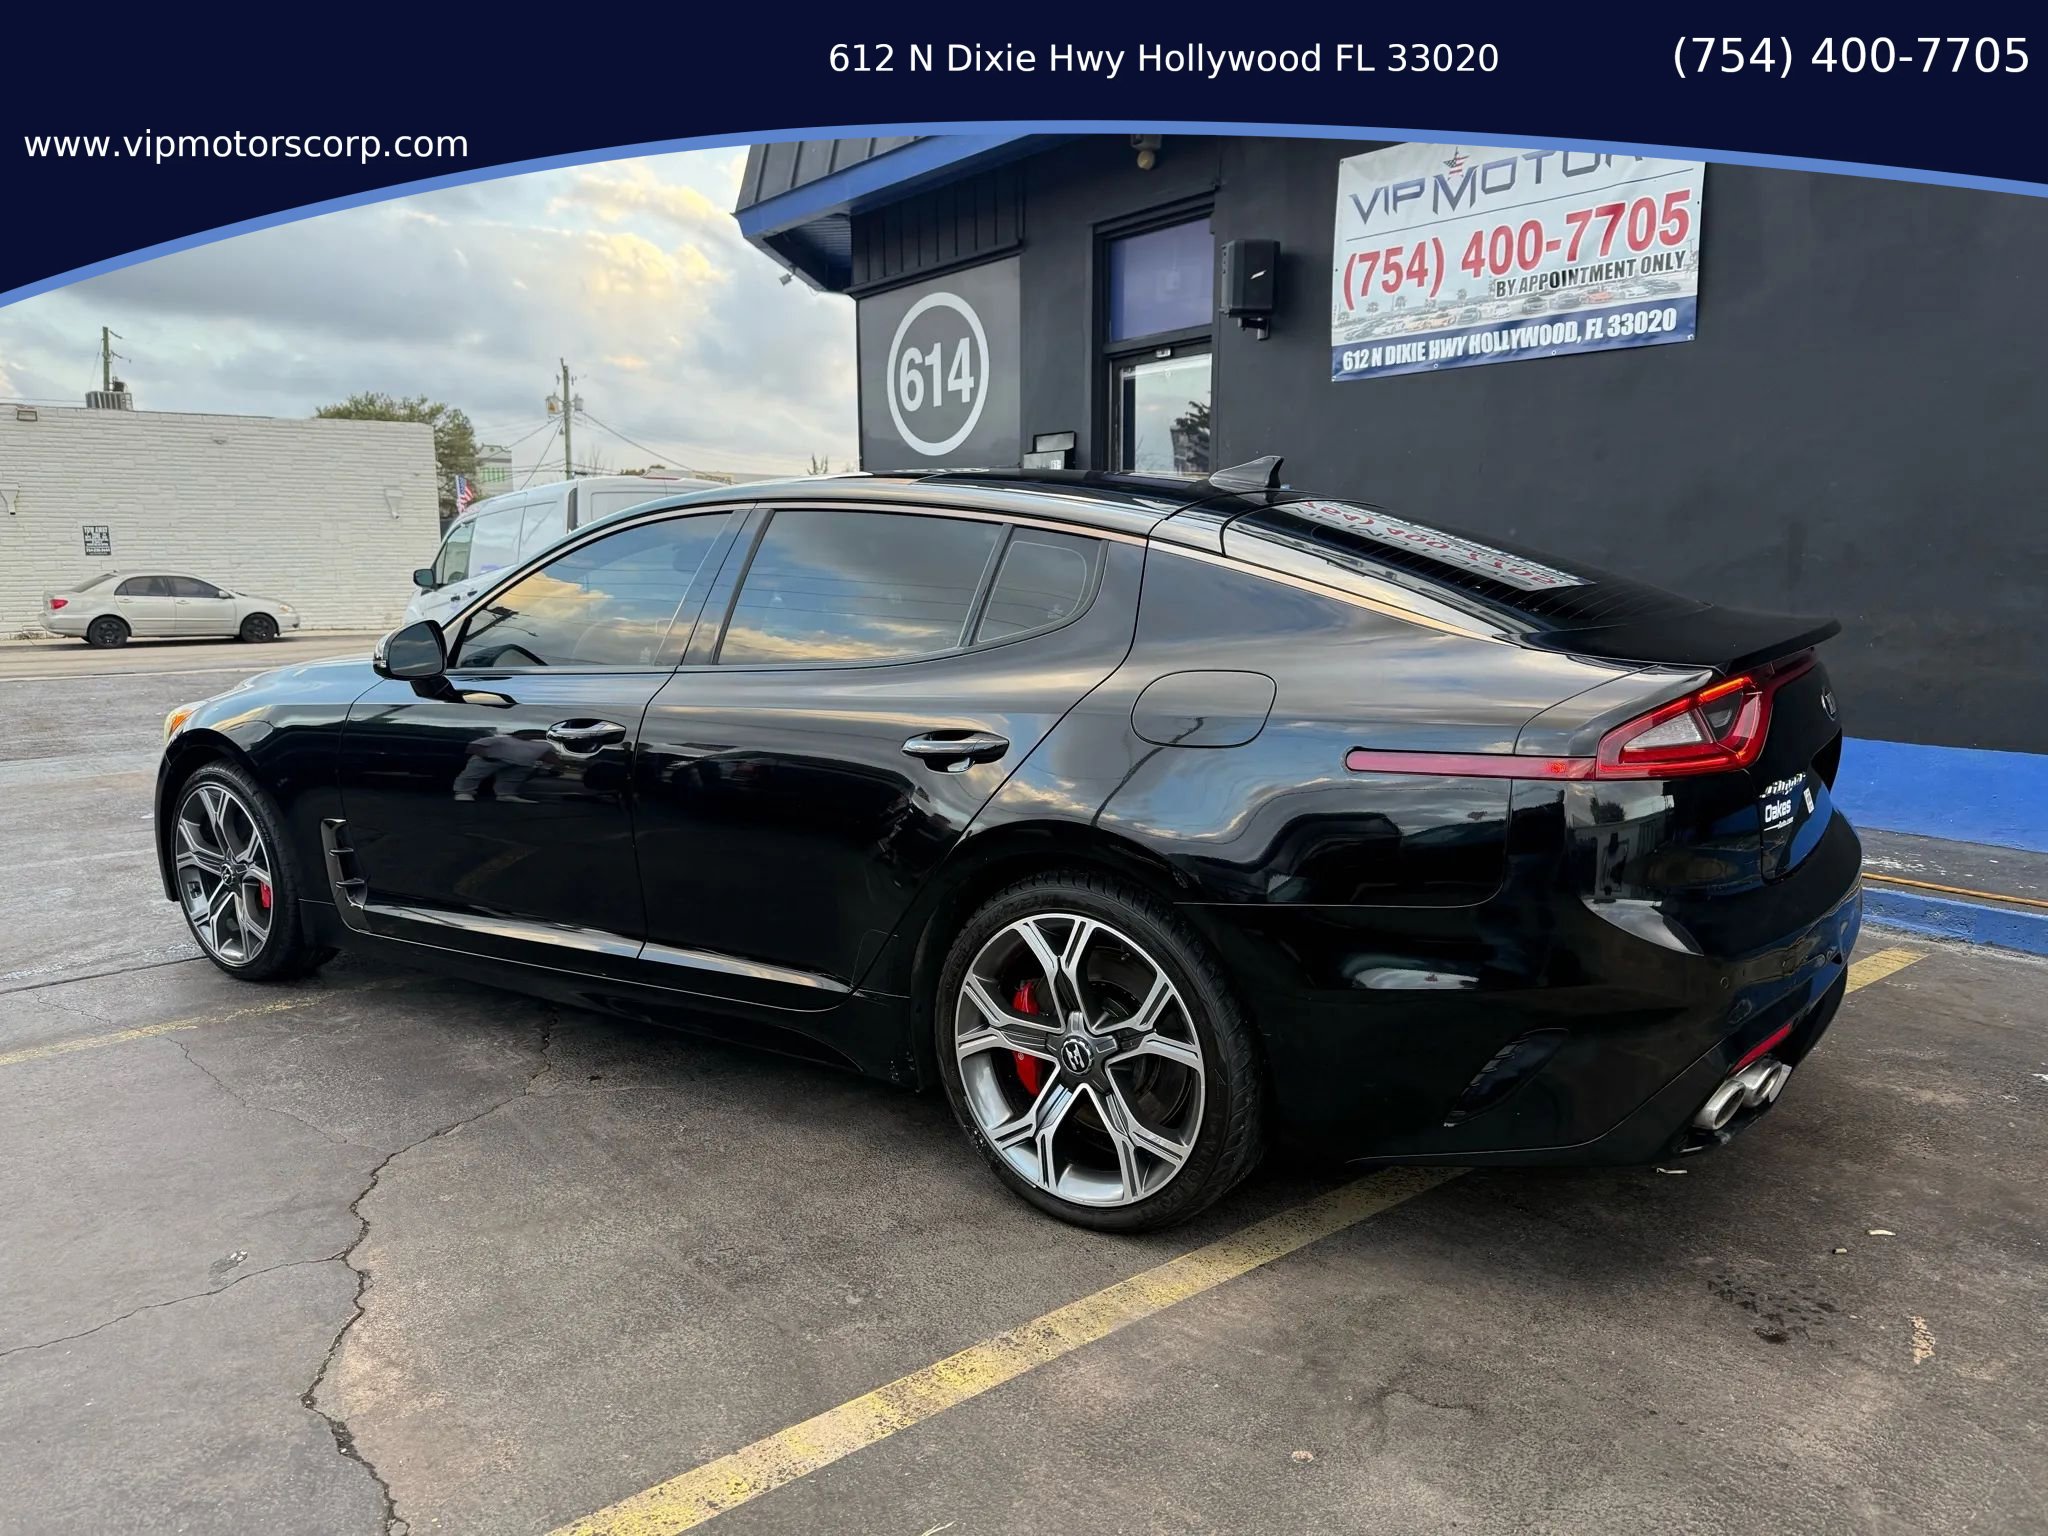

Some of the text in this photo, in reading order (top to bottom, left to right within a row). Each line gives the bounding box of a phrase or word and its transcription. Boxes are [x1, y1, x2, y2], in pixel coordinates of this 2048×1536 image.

[1343, 189, 1692, 310] (754) 400-7705
[1496, 250, 1686, 298] BY APPOINTMENT ONLY
[1342, 307, 1677, 371] 612 N DIXIE HWY HOLLYWOOD, FL 33020
[900, 337, 975, 412] 614
[1764, 799, 1792, 823] Oakes
